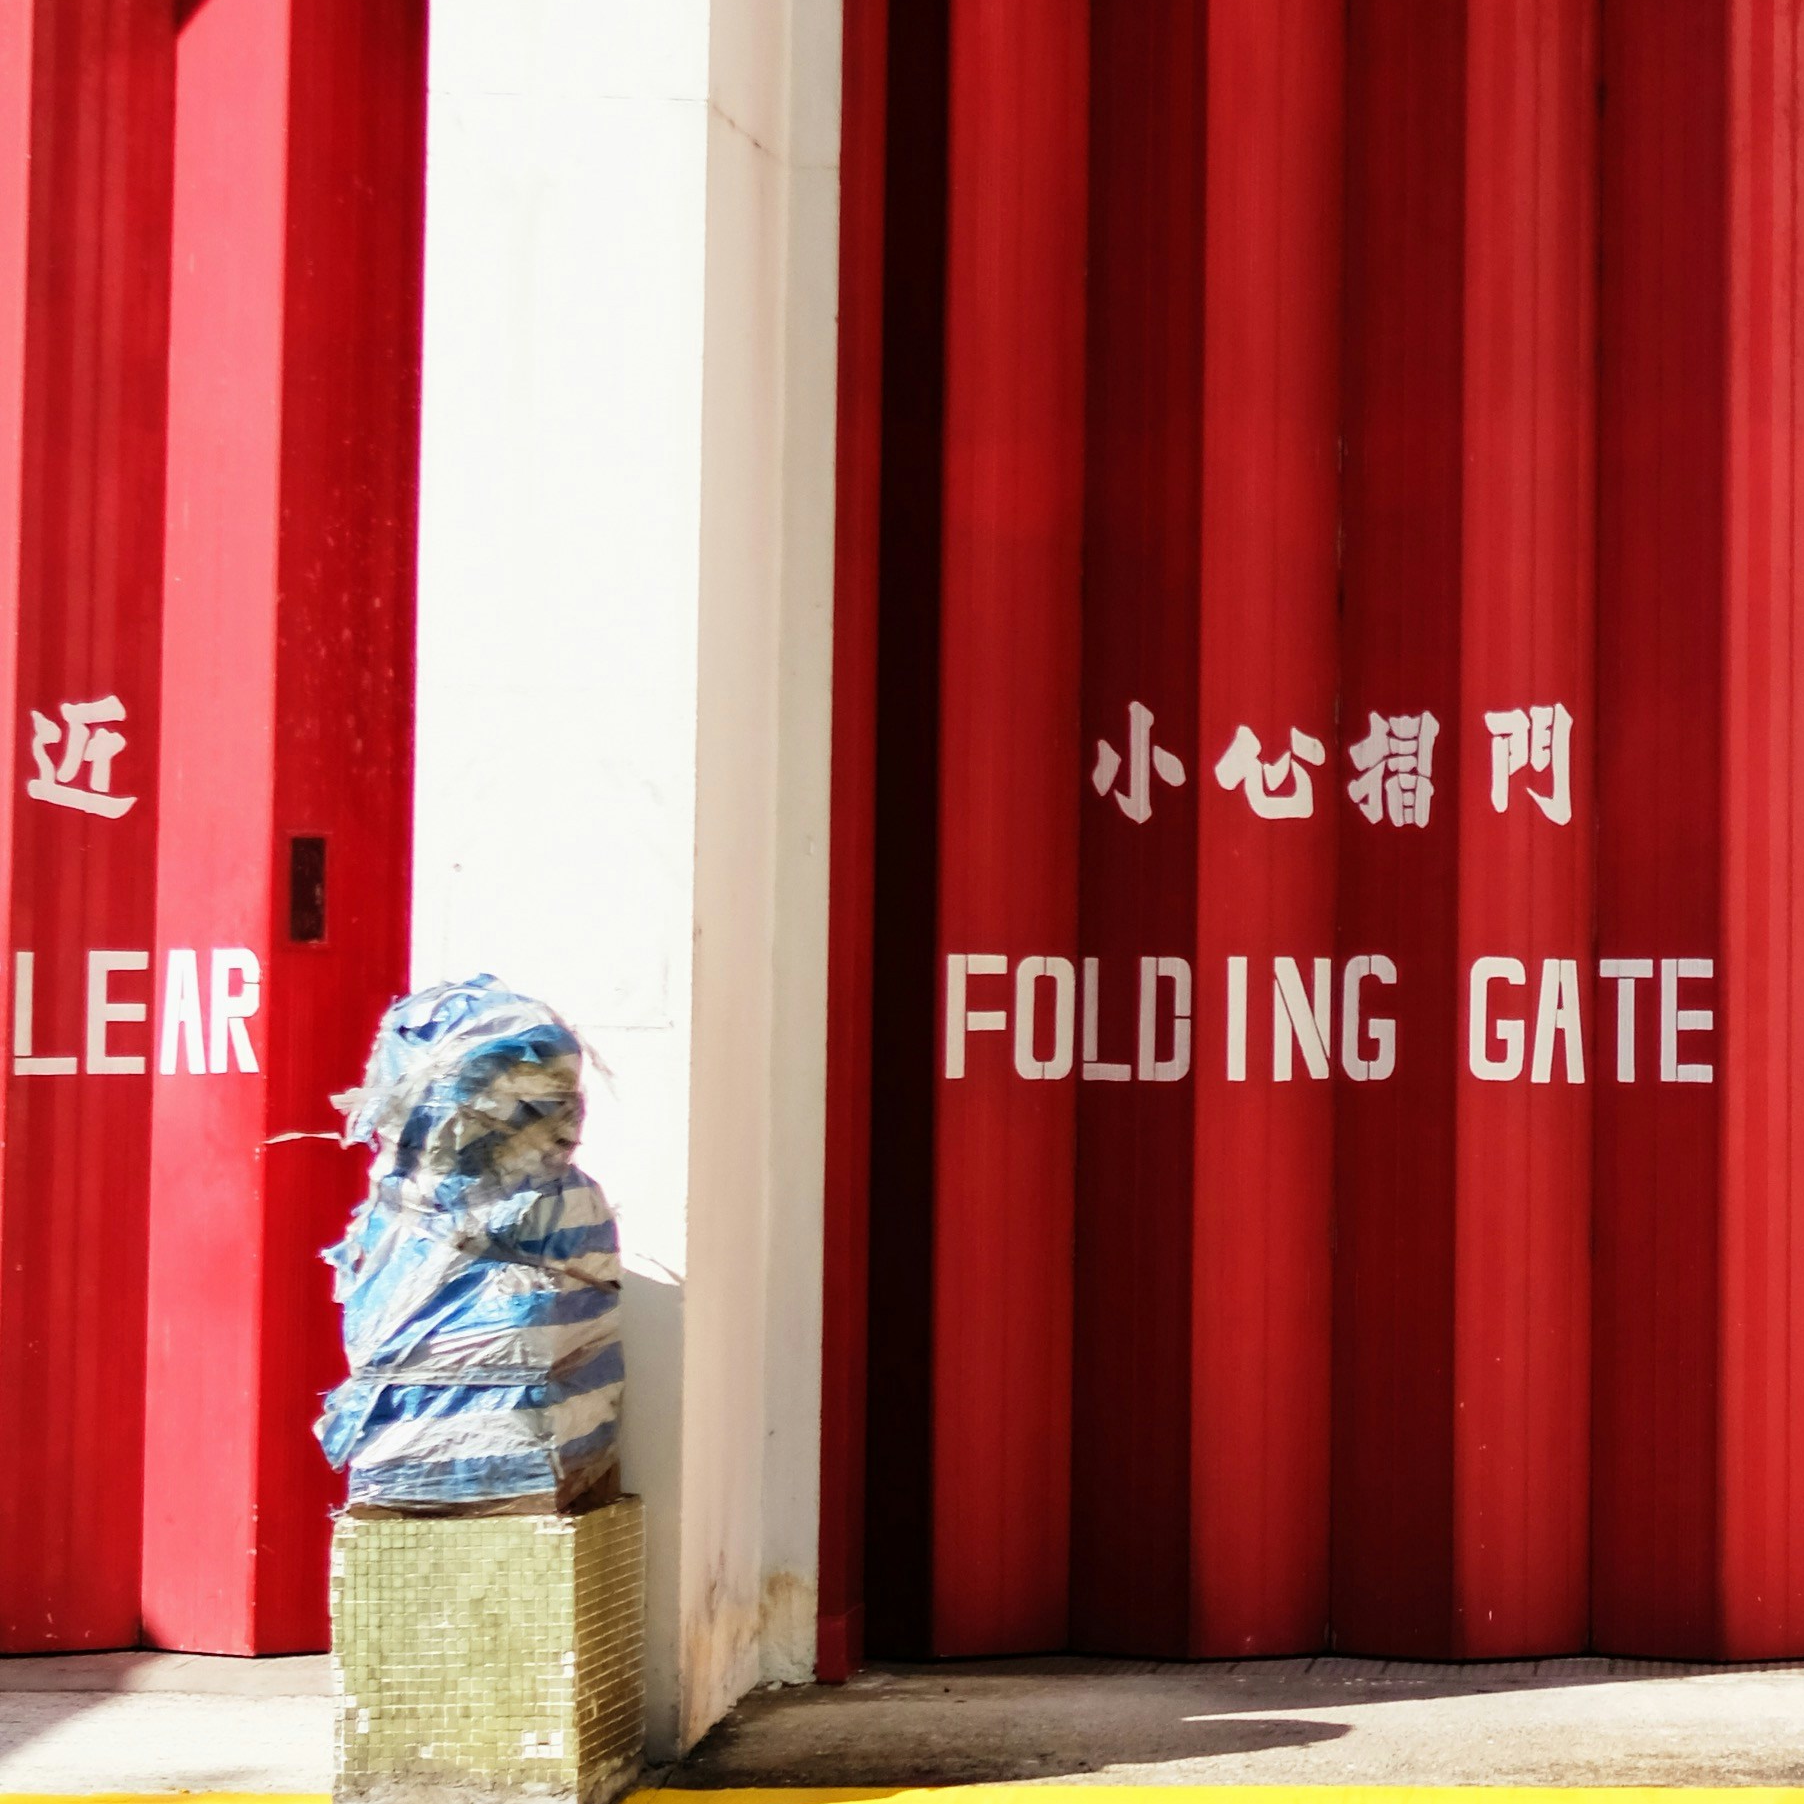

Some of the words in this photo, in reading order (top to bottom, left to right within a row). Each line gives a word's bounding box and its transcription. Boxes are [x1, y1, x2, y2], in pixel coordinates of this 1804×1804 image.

[27, 695, 137, 819] 近
[944, 953, 1397, 1082] FOLDING
[1469, 957, 1714, 1084] GATE
